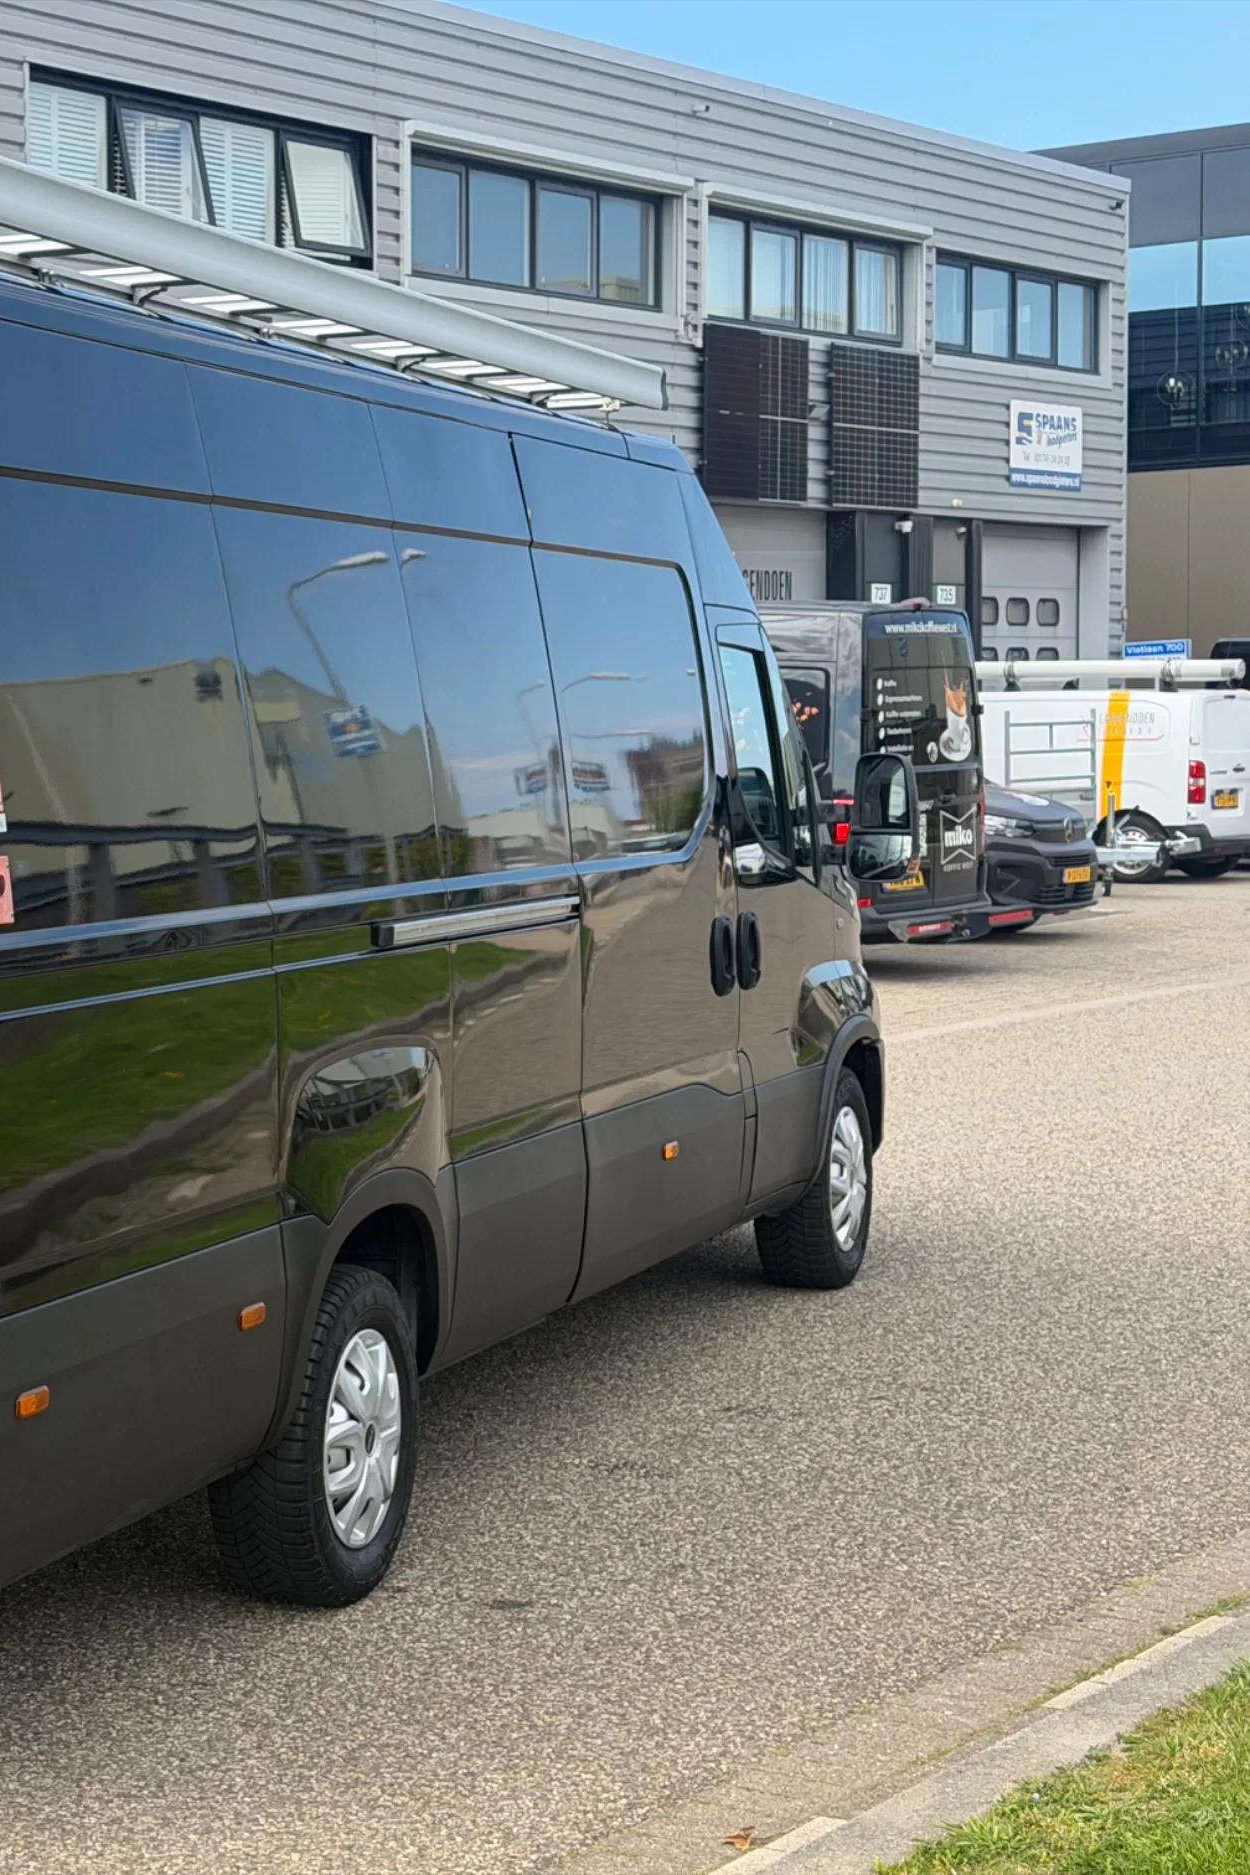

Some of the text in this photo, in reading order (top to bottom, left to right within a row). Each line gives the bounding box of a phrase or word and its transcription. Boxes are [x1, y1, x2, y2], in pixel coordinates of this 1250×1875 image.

[1035, 412, 1077, 431] SPAANS
[873, 586, 888, 600] 737
[939, 588, 954, 602] 735
[1165, 641, 1185, 652] 700
[944, 825, 973, 847] miko
